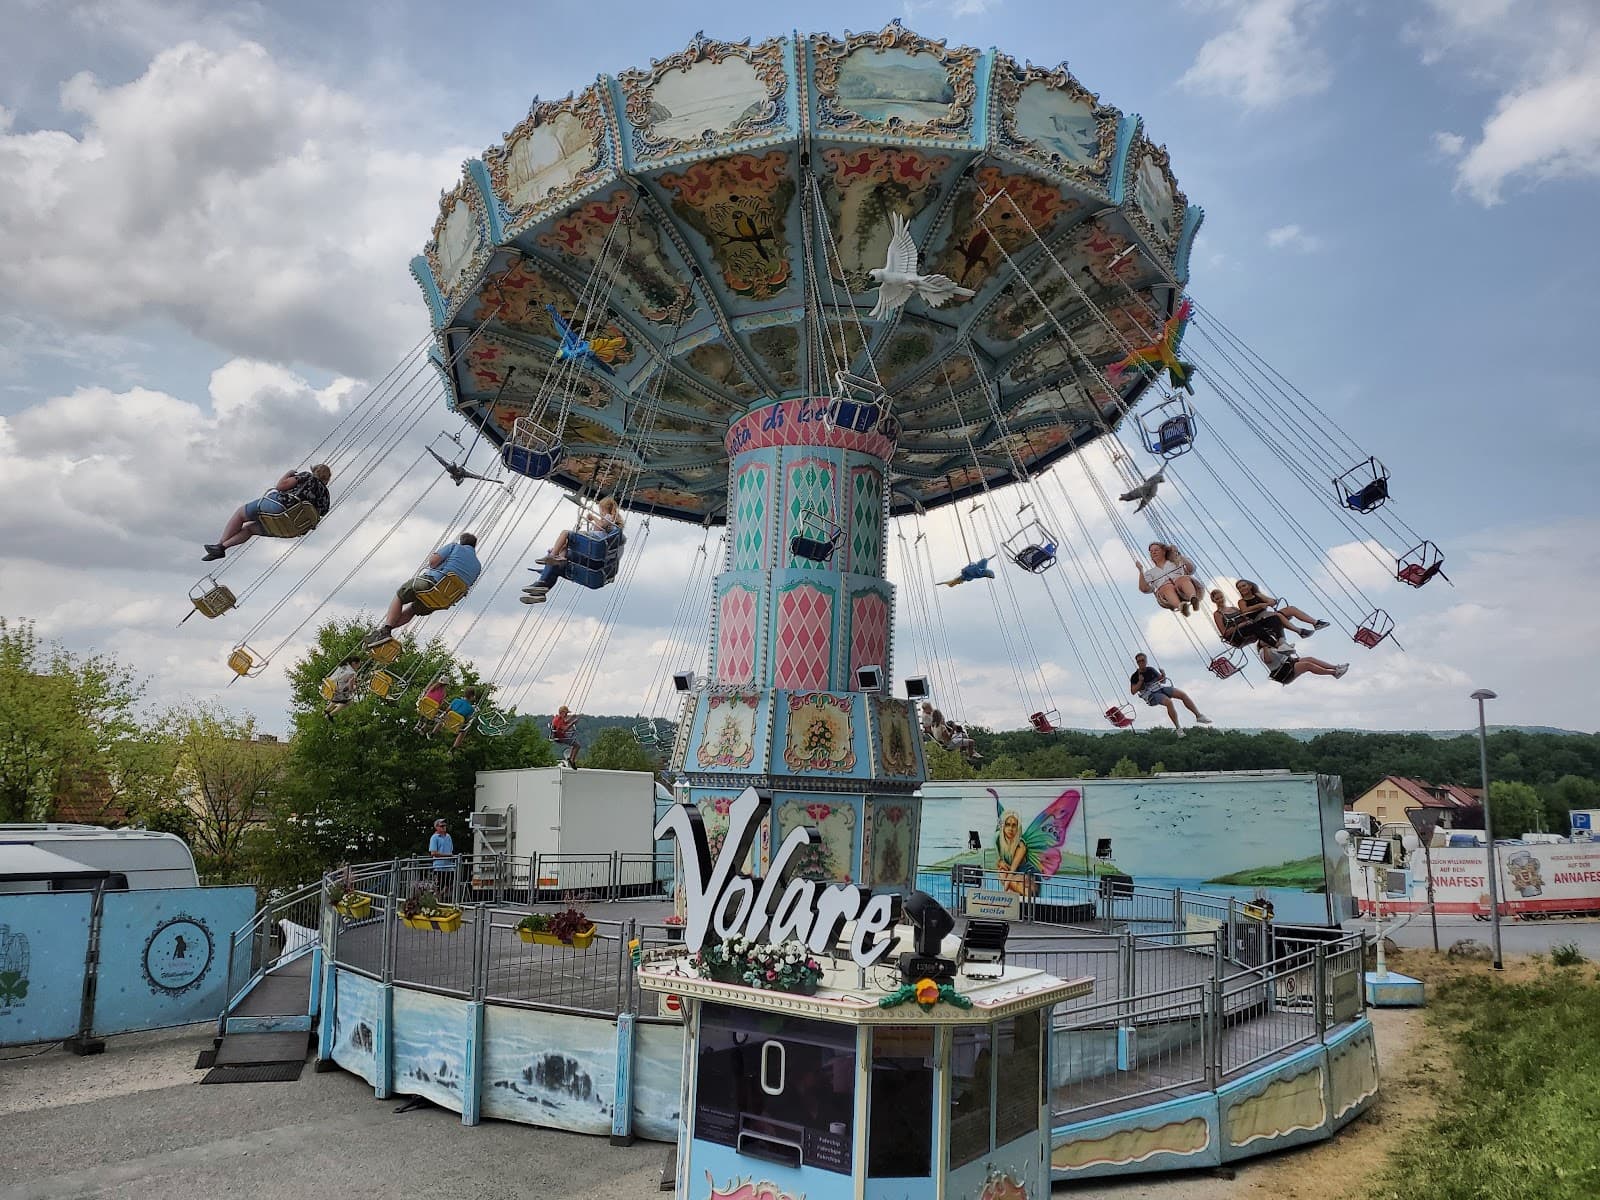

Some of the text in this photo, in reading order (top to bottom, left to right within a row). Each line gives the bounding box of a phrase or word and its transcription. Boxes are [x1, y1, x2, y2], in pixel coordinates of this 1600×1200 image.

[762, 402, 785, 432] di
[1577, 815, 1586, 827] P
[654, 786, 895, 967] Volare
[1554, 871, 1600, 884] ANNAFES
